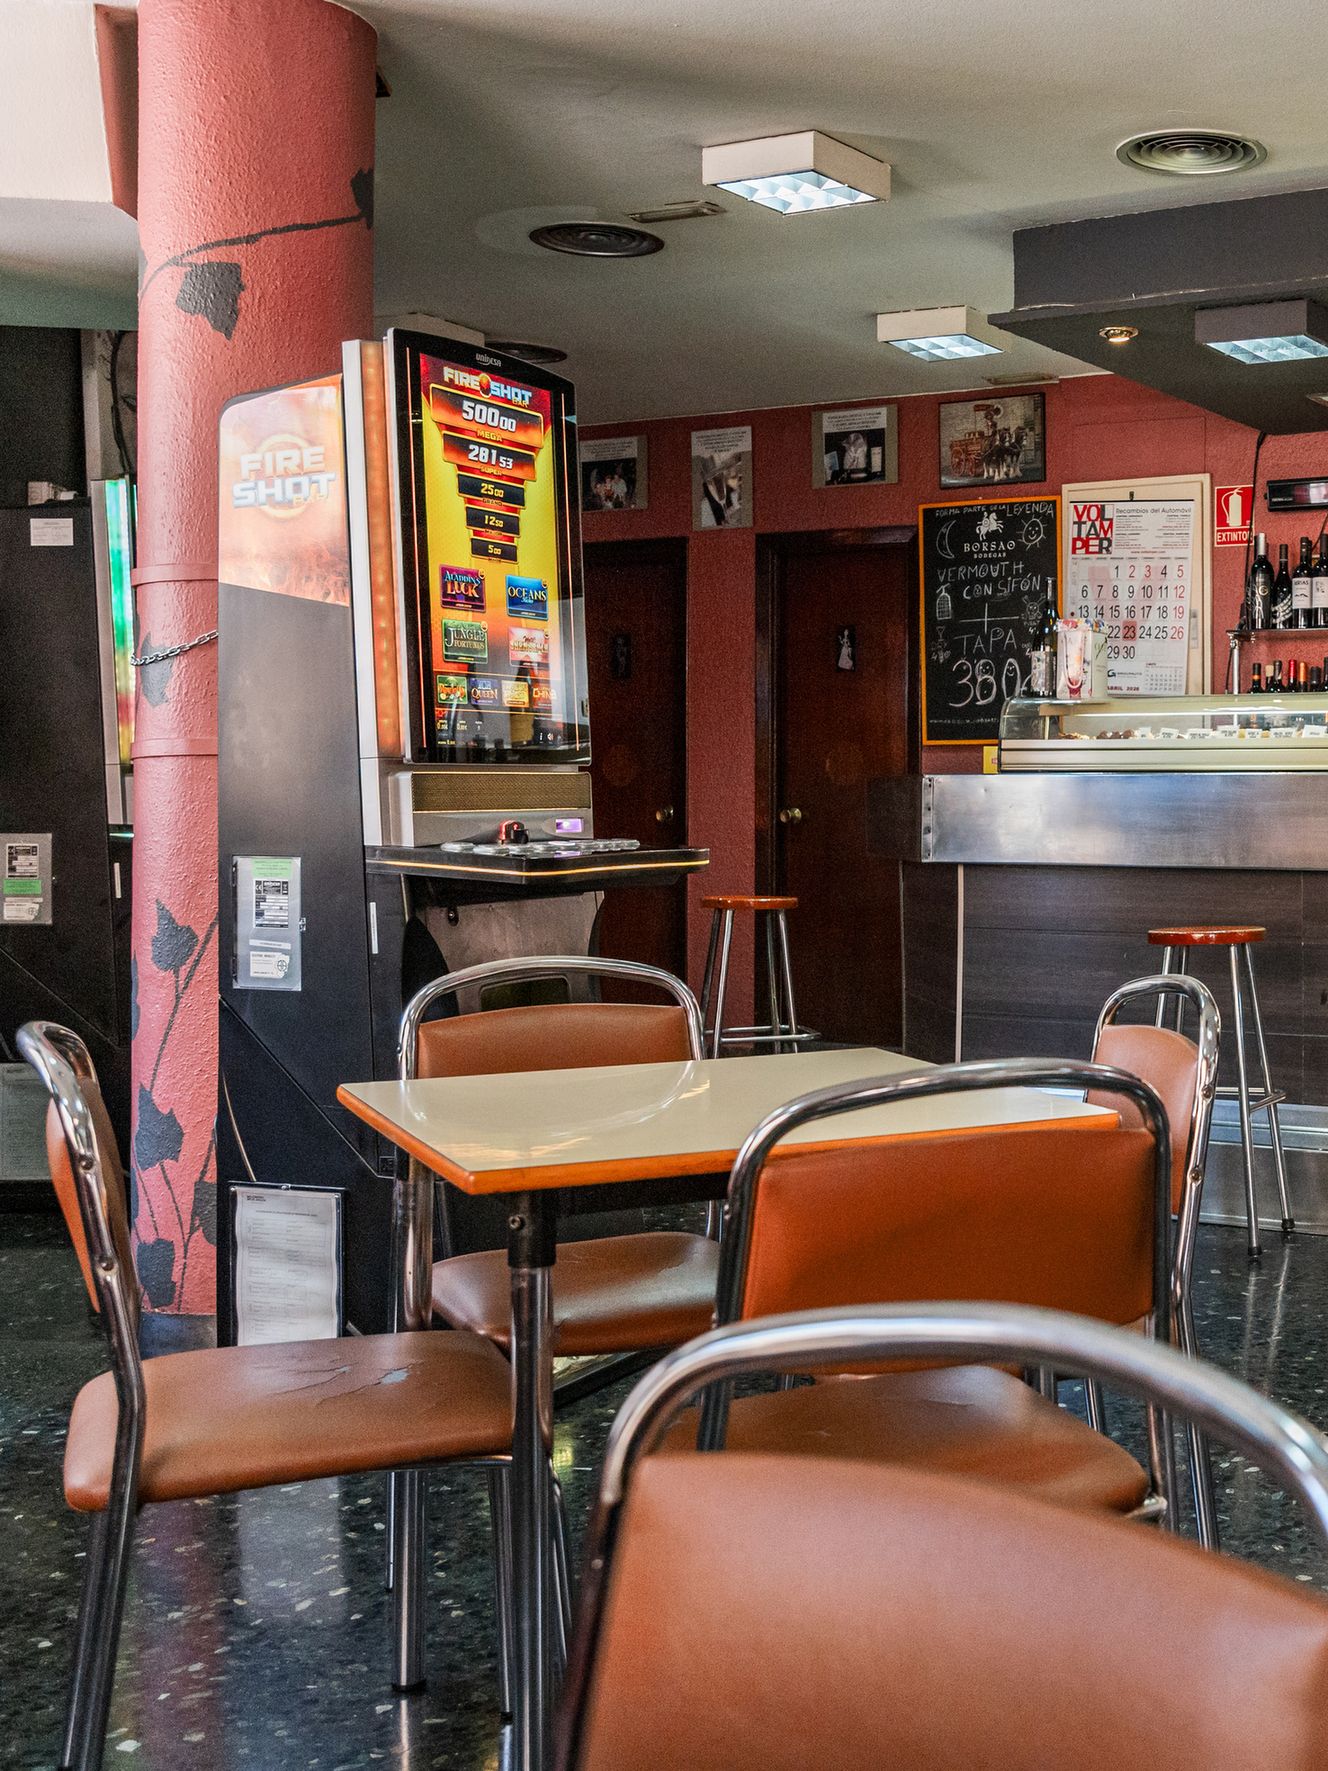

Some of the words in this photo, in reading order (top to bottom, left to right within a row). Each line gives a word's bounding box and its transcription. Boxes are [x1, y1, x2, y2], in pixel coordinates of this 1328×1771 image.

[443, 366, 480, 390] FIRE
[490, 380, 532, 405] SHOT
[477, 428, 503, 442] MEGA
[240, 446, 325, 480] FIRE
[232, 472, 336, 509] SHOT
[963, 504, 986, 513] PARTE
[1006, 502, 1055, 518] LEYENDA
[1073, 504, 1114, 521] VOL
[1161, 506, 1192, 514] Automóvil
[1073, 521, 1114, 538] TAM
[963, 540, 1016, 553] BORSAO
[1072, 537, 1113, 554] PER
[937, 561, 1024, 582] VERMOUTH
[1114, 565, 1119, 578] 1
[1128, 565, 1136, 578] 2
[1144, 565, 1152, 578] 3
[1160, 565, 1168, 578] 4
[1177, 565, 1184, 578] 5
[446, 581, 480, 598] LUCK
[508, 586, 547, 600] OCEANS
[963, 583, 993, 599] CON
[998, 573, 1041, 594] SIFÓN
[1081, 585, 1088, 598] 6
[1097, 585, 1104, 598] 7
[1112, 585, 1119, 598] 8
[1127, 585, 1135, 598] 9
[1141, 585, 1153, 598] 10
[1158, 585, 1168, 598] 11
[1174, 585, 1185, 598] 12
[1078, 605, 1089, 618] 13
[1093, 605, 1105, 618] 14
[1109, 605, 1120, 618] 15
[1124, 605, 1136, 618] 16
[1140, 605, 1152, 618] 17
[1157, 605, 1168, 618] 18
[1173, 605, 1185, 618] 19
[444, 627, 485, 647] JUNGLE
[1107, 625, 1120, 639] 22
[1123, 625, 1136, 639] 23
[1139, 625, 1152, 639] 24
[1154, 625, 1168, 639] 25
[1170, 625, 1184, 639] 26
[953, 627, 1017, 655] TAPA
[1107, 645, 1120, 659] 29
[1122, 645, 1136, 659] 30
[471, 688, 498, 700] QUEEN
